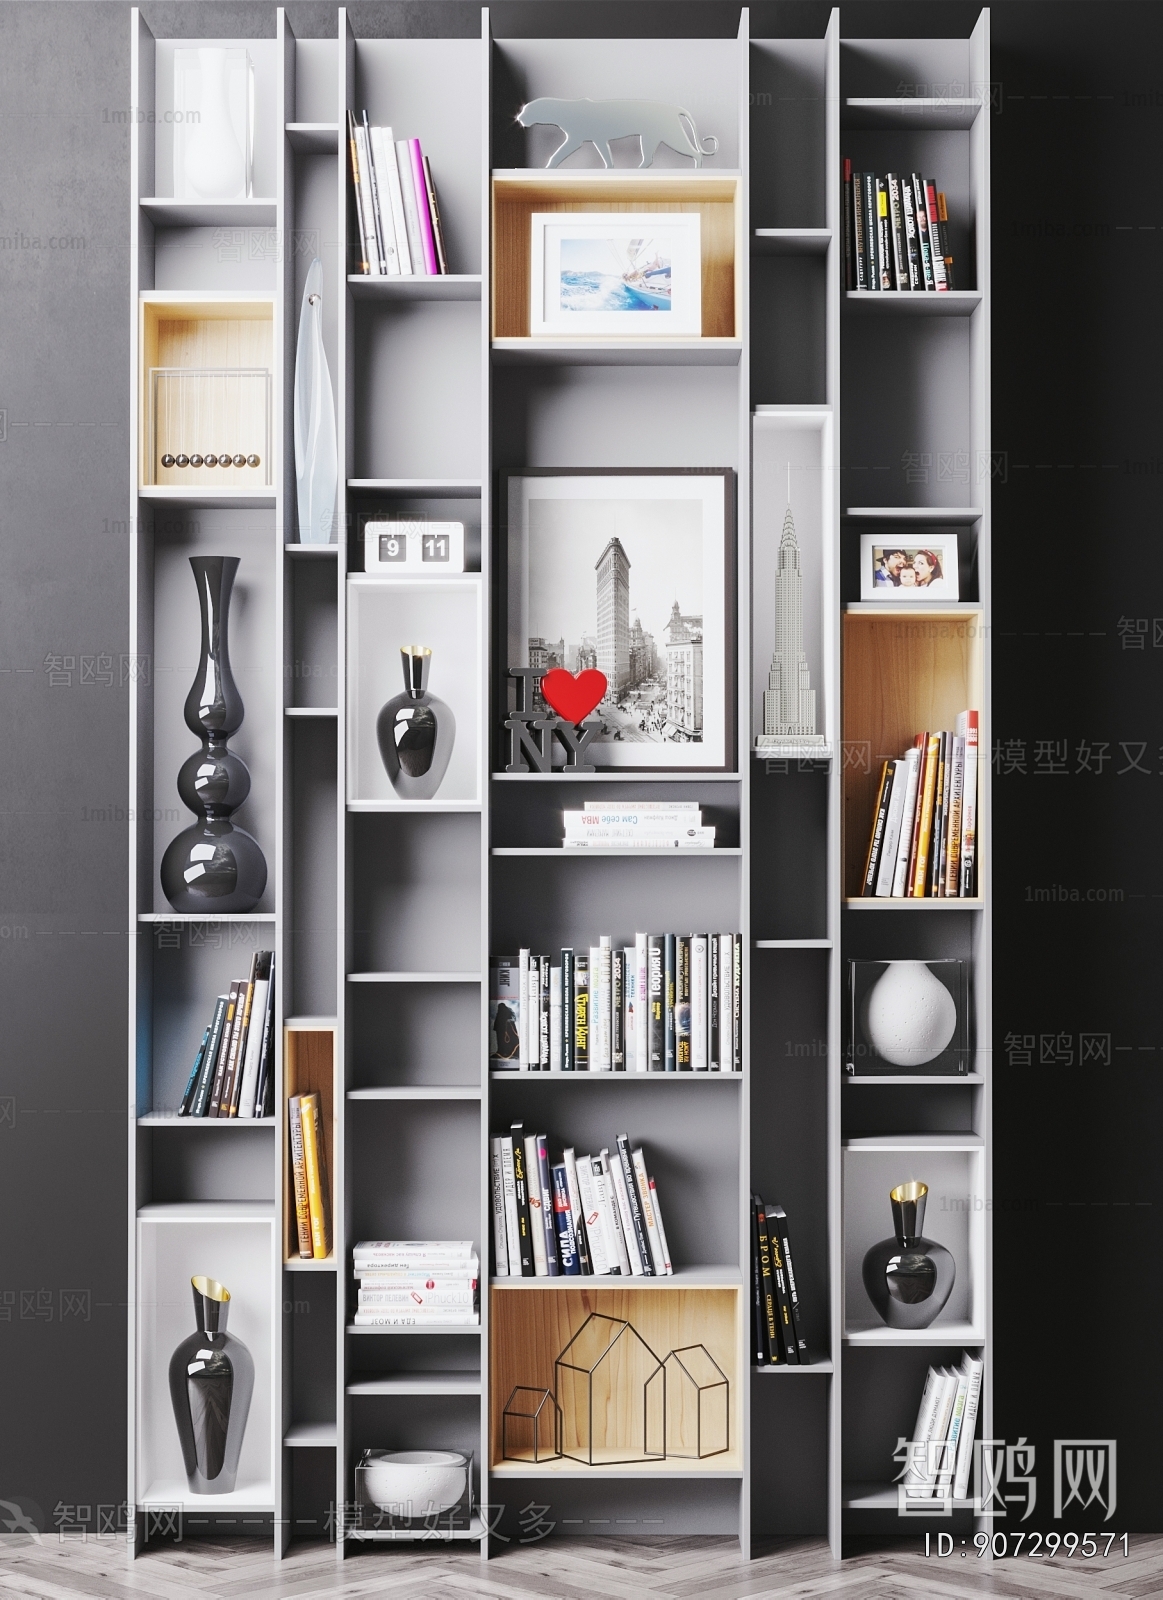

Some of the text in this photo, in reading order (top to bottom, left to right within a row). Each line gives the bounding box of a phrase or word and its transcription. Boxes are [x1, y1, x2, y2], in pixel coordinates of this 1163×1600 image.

[890, 179, 901, 228] МЕТРО 2034
[386, 539, 446, 557] 9 11
[509, 667, 548, 720] I
[504, 720, 605, 774] NY
[952, 761, 963, 808] АРХИТЕКТУРЫ
[601, 815, 620, 824] себе
[622, 815, 637, 824] Сам
[949, 812, 960, 858] СОВРЕМЕННОЙ
[948, 860, 958, 881] ГЕНИИ
[601, 946, 610, 983] СПЛИН
[499, 969, 509, 986] КИНГ
[649, 957, 662, 997] Теория
[209, 1033, 217, 1050] ШКОЛА
[227, 1059, 235, 1071] КАК
[503, 1147, 511, 1167] ПЛЕМЯ
[619, 1148, 632, 1174] времени
[291, 1121, 309, 1243] ГЕНИИ СОВРЕМЕННОЙ АРХИТЕКТУРЫ
[505, 1177, 514, 1196] ЛИДЕР
[578, 1164, 591, 1186] ВИКТОР
[625, 1174, 632, 1182] во
[541, 1187, 551, 1211] СДВИГ
[581, 1186, 596, 1211] ПЕЛЕВИН
[594, 1178, 608, 1207] Лавр
[626, 1182, 642, 1221] Путешествия
[636, 1171, 654, 1227] МАСТЕР ЗВОНКА
[564, 1209, 576, 1254] ПОДСОЗНАНИЯ
[558, 1230, 573, 1267] СИЛА
[586, 1226, 610, 1271] iPhuck10
[757, 1234, 770, 1276] БРОМ
[425, 1292, 468, 1303] iPhuck10
[764, 1294, 774, 1315] СЕРДЦЕ
[767, 1322, 776, 1338] ТЕНИ
[930, 1396, 941, 1418] ДУМАЮТ
[966, 1400, 976, 1420] ЛИДЕР
[927, 1418, 935, 1433] ЛЮДИ
[947, 1394, 964, 1451] Развитие мозга
